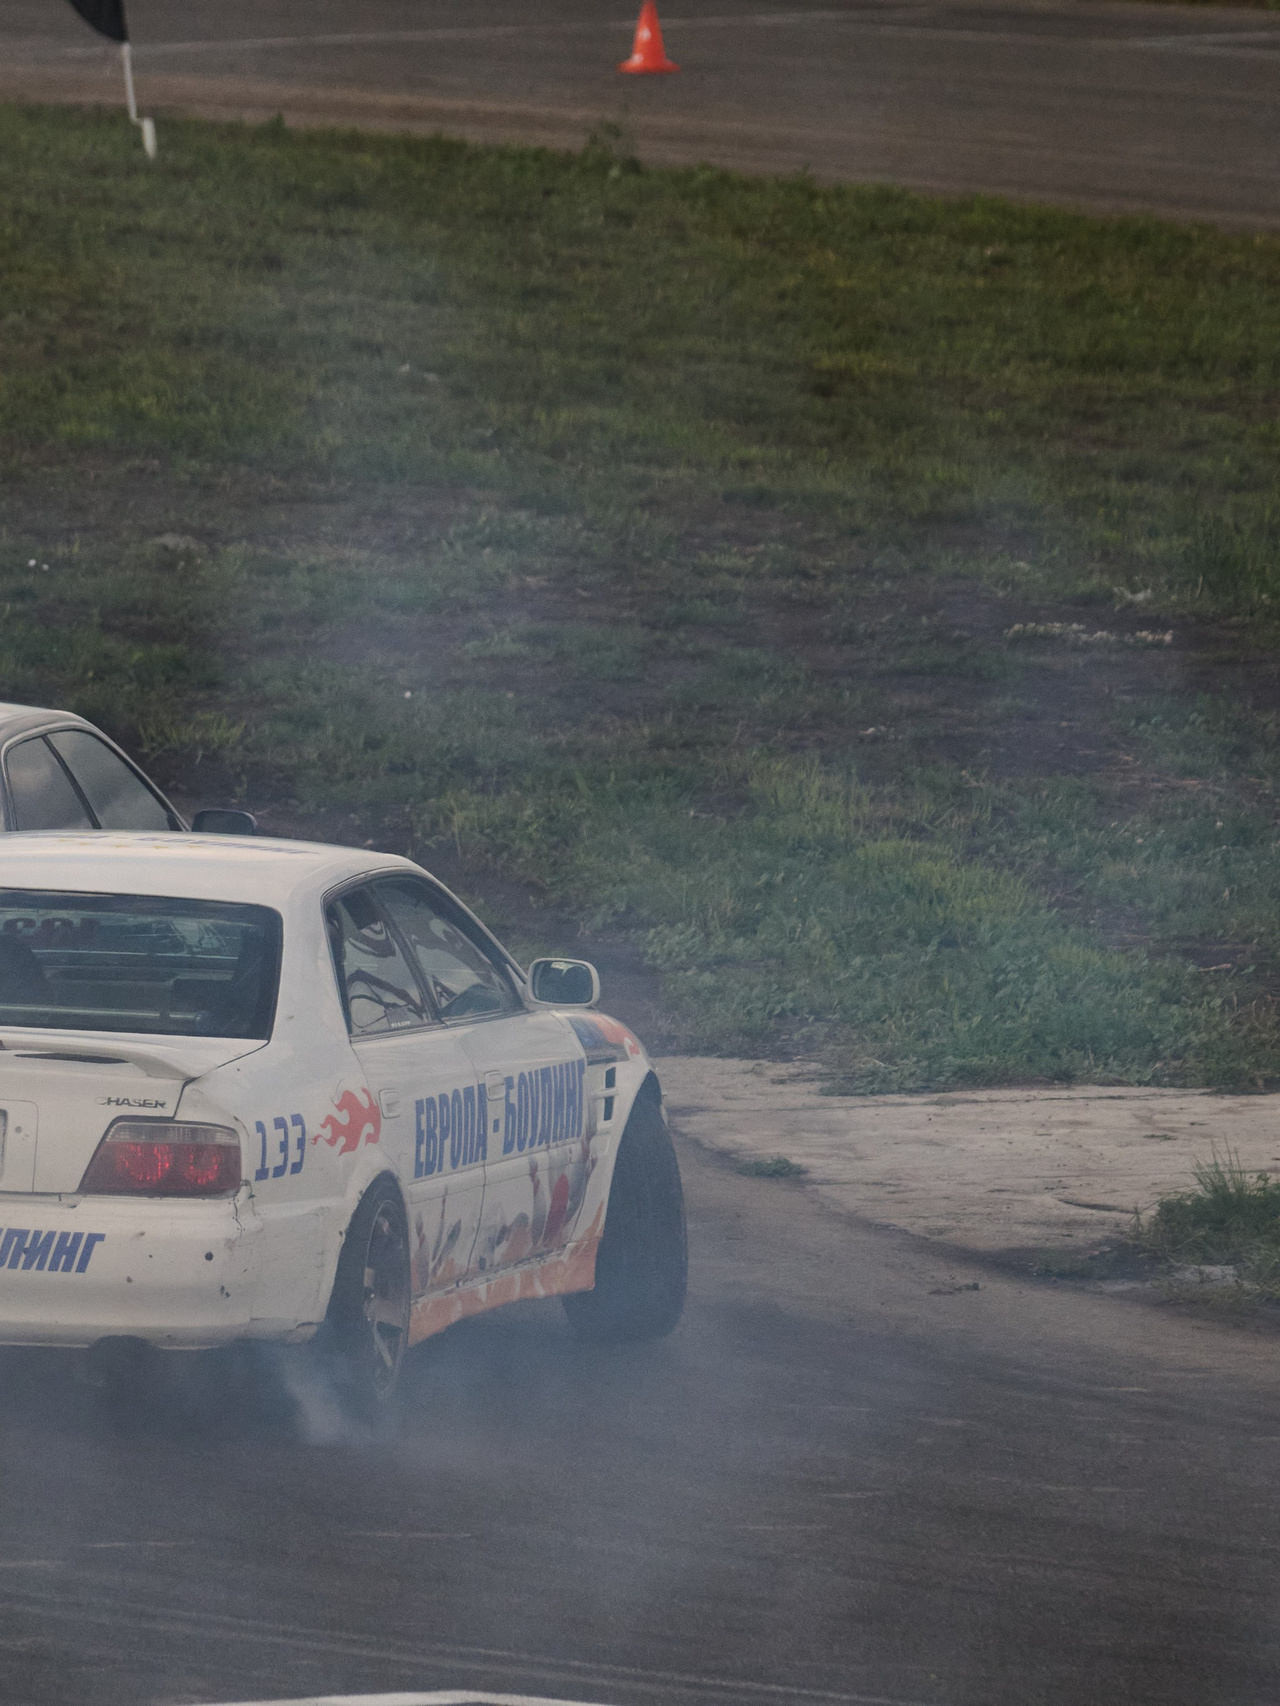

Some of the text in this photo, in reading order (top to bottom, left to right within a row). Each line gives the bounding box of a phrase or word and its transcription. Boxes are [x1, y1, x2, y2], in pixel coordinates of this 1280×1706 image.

[255, 1113, 306, 1182] 133
[414, 1083, 488, 1179] ЕВРОПА
[502, 1058, 586, 1155] БОУЛИНГ
